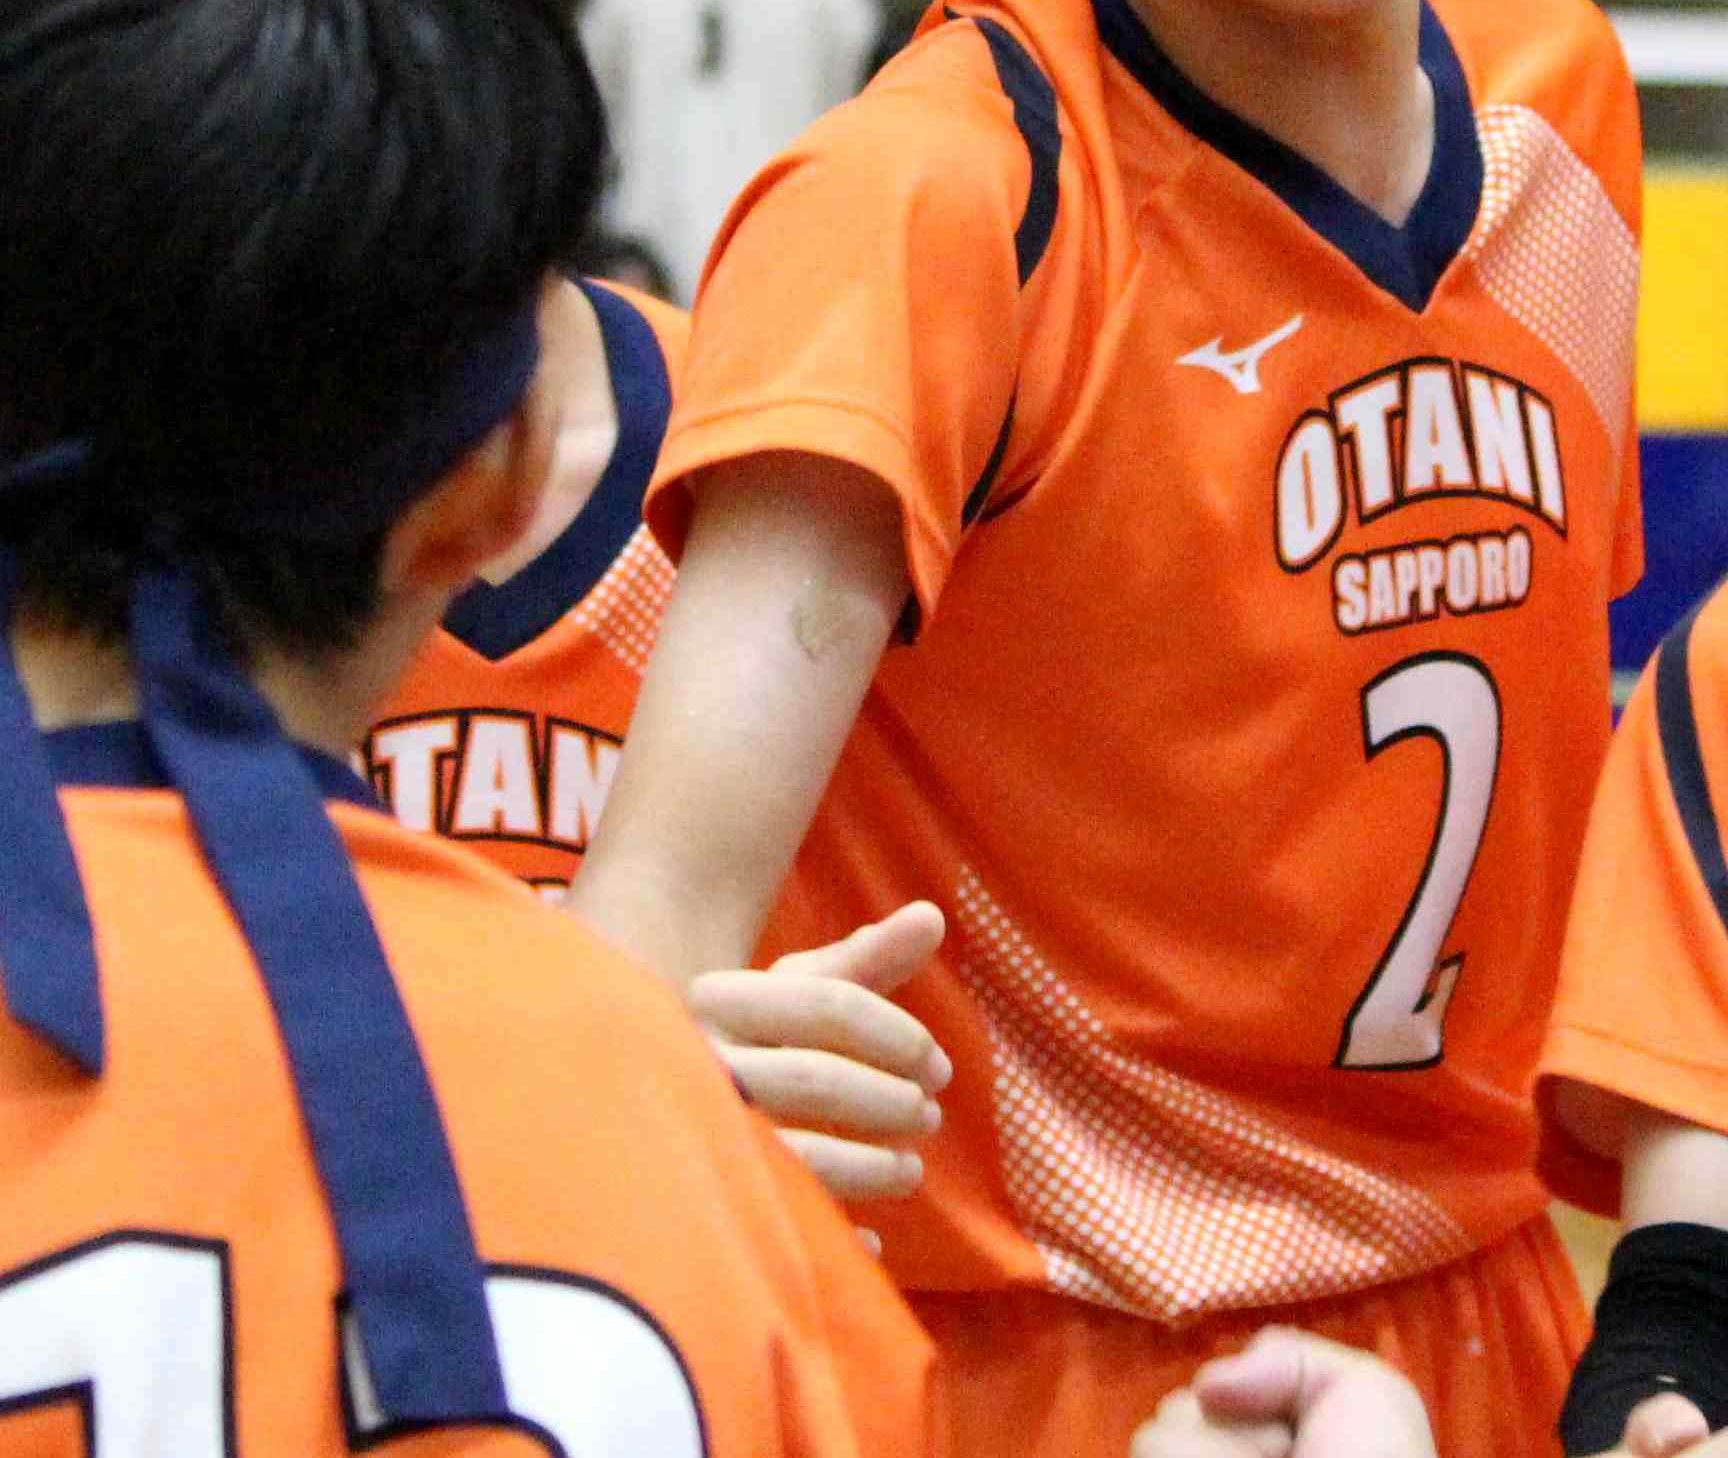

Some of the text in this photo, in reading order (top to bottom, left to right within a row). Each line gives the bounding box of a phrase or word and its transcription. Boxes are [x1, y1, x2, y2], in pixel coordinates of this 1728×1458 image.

[1275, 355, 1569, 574] OTANI
[1332, 525, 1533, 636] SAPPORO
[352, 706, 626, 855] TAN
[1336, 649, 1502, 1071] 2
